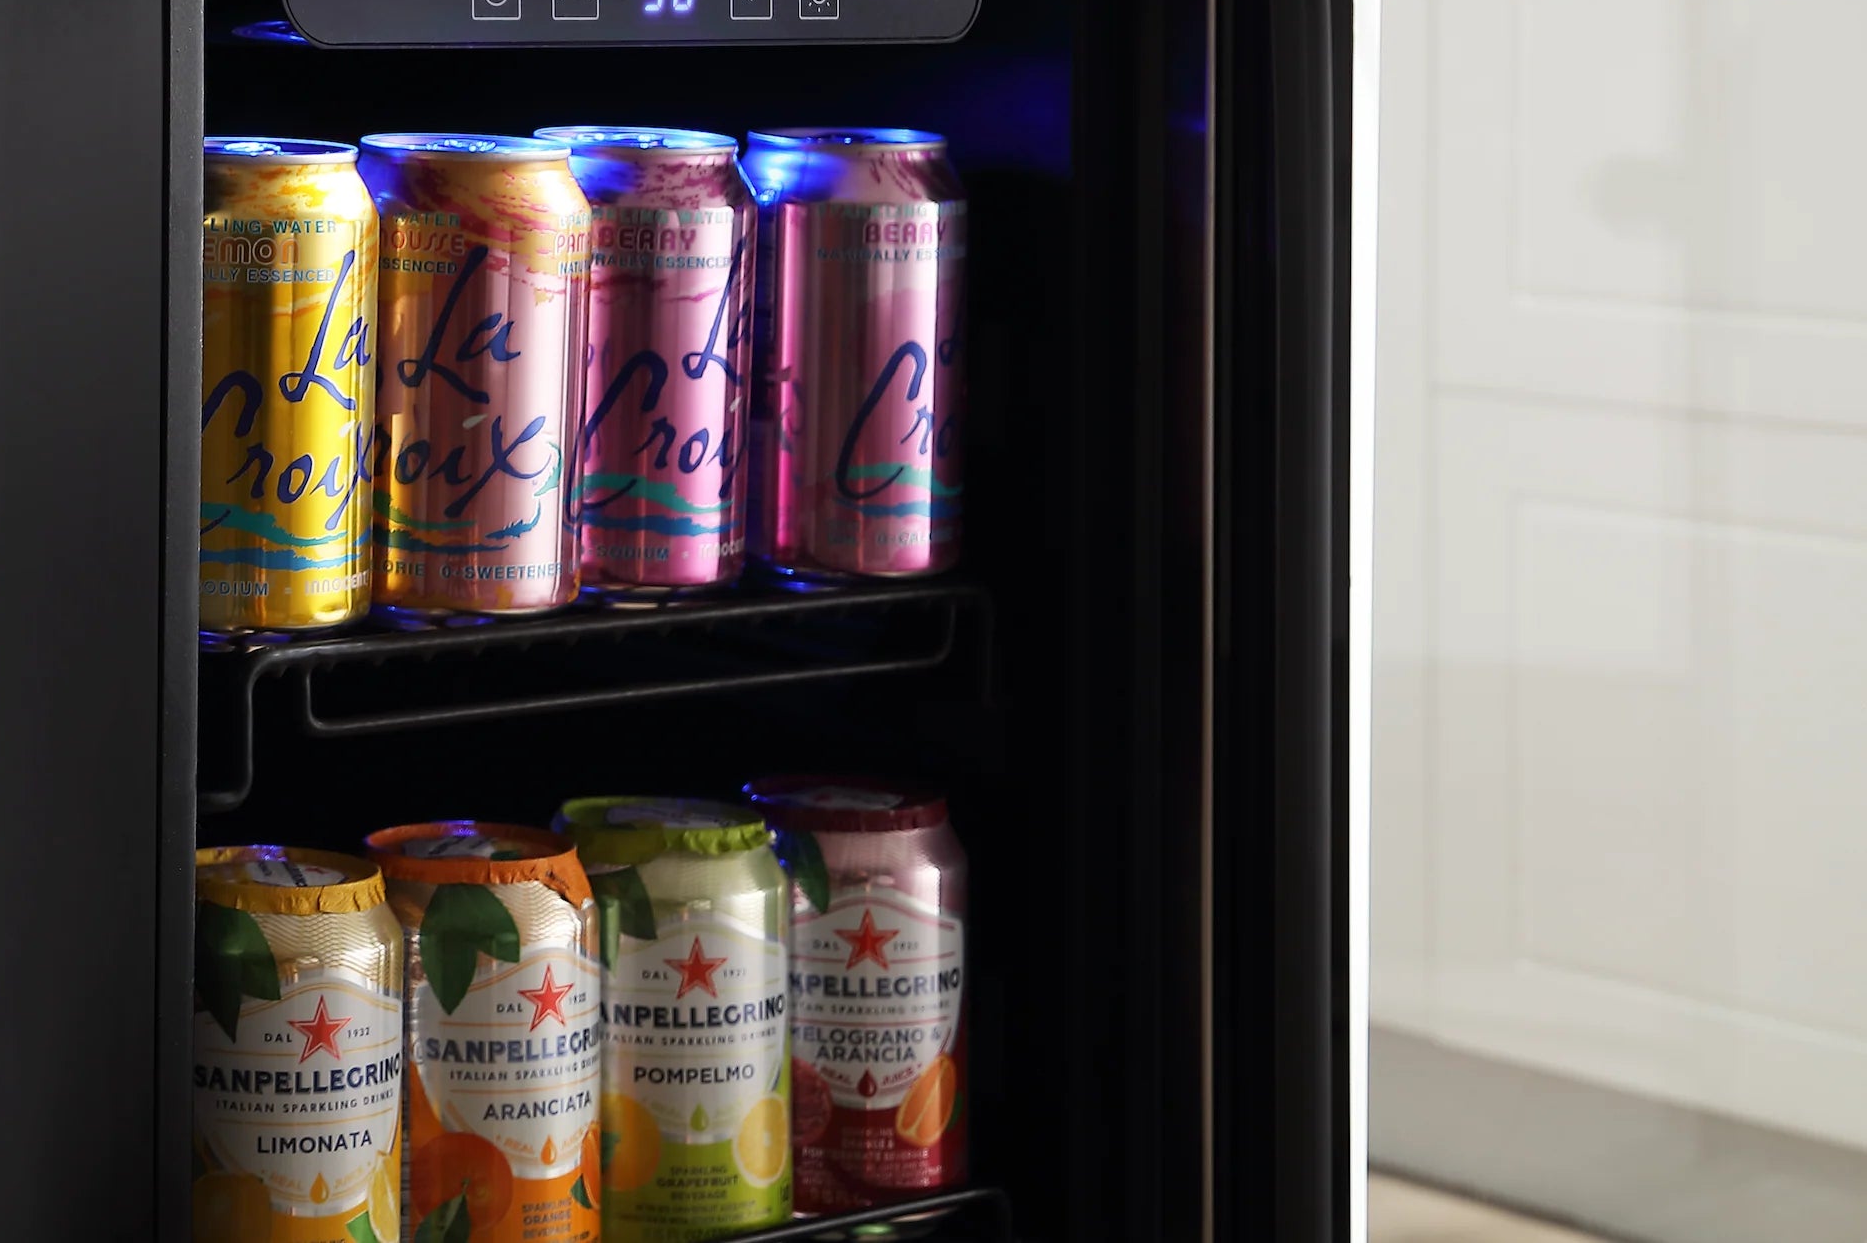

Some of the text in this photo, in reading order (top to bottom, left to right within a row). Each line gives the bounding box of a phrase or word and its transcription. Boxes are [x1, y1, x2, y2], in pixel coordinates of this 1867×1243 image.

[273, 220, 337, 234] WATER
[247, 268, 336, 283] ESSENCED
[279, 248, 373, 413] La
[397, 244, 522, 405] La
[200, 579, 270, 597] ODIUM
[640, 969, 670, 981] DAL
[496, 1003, 524, 1014] DAL
[264, 1026, 371, 1045] DAL 1932
[816, 1045, 916, 1063] ARANCIA
[194, 1052, 402, 1095] SANPELLEGRINO
[449, 1069, 509, 1082] ITALIAN
[633, 1064, 755, 1085] POMPELMO
[216, 1099, 276, 1114] ITALIAN
[282, 1098, 359, 1114] SPARKLING
[483, 1089, 593, 1121] ARANCIATA
[257, 1128, 374, 1155] LIMONATA
